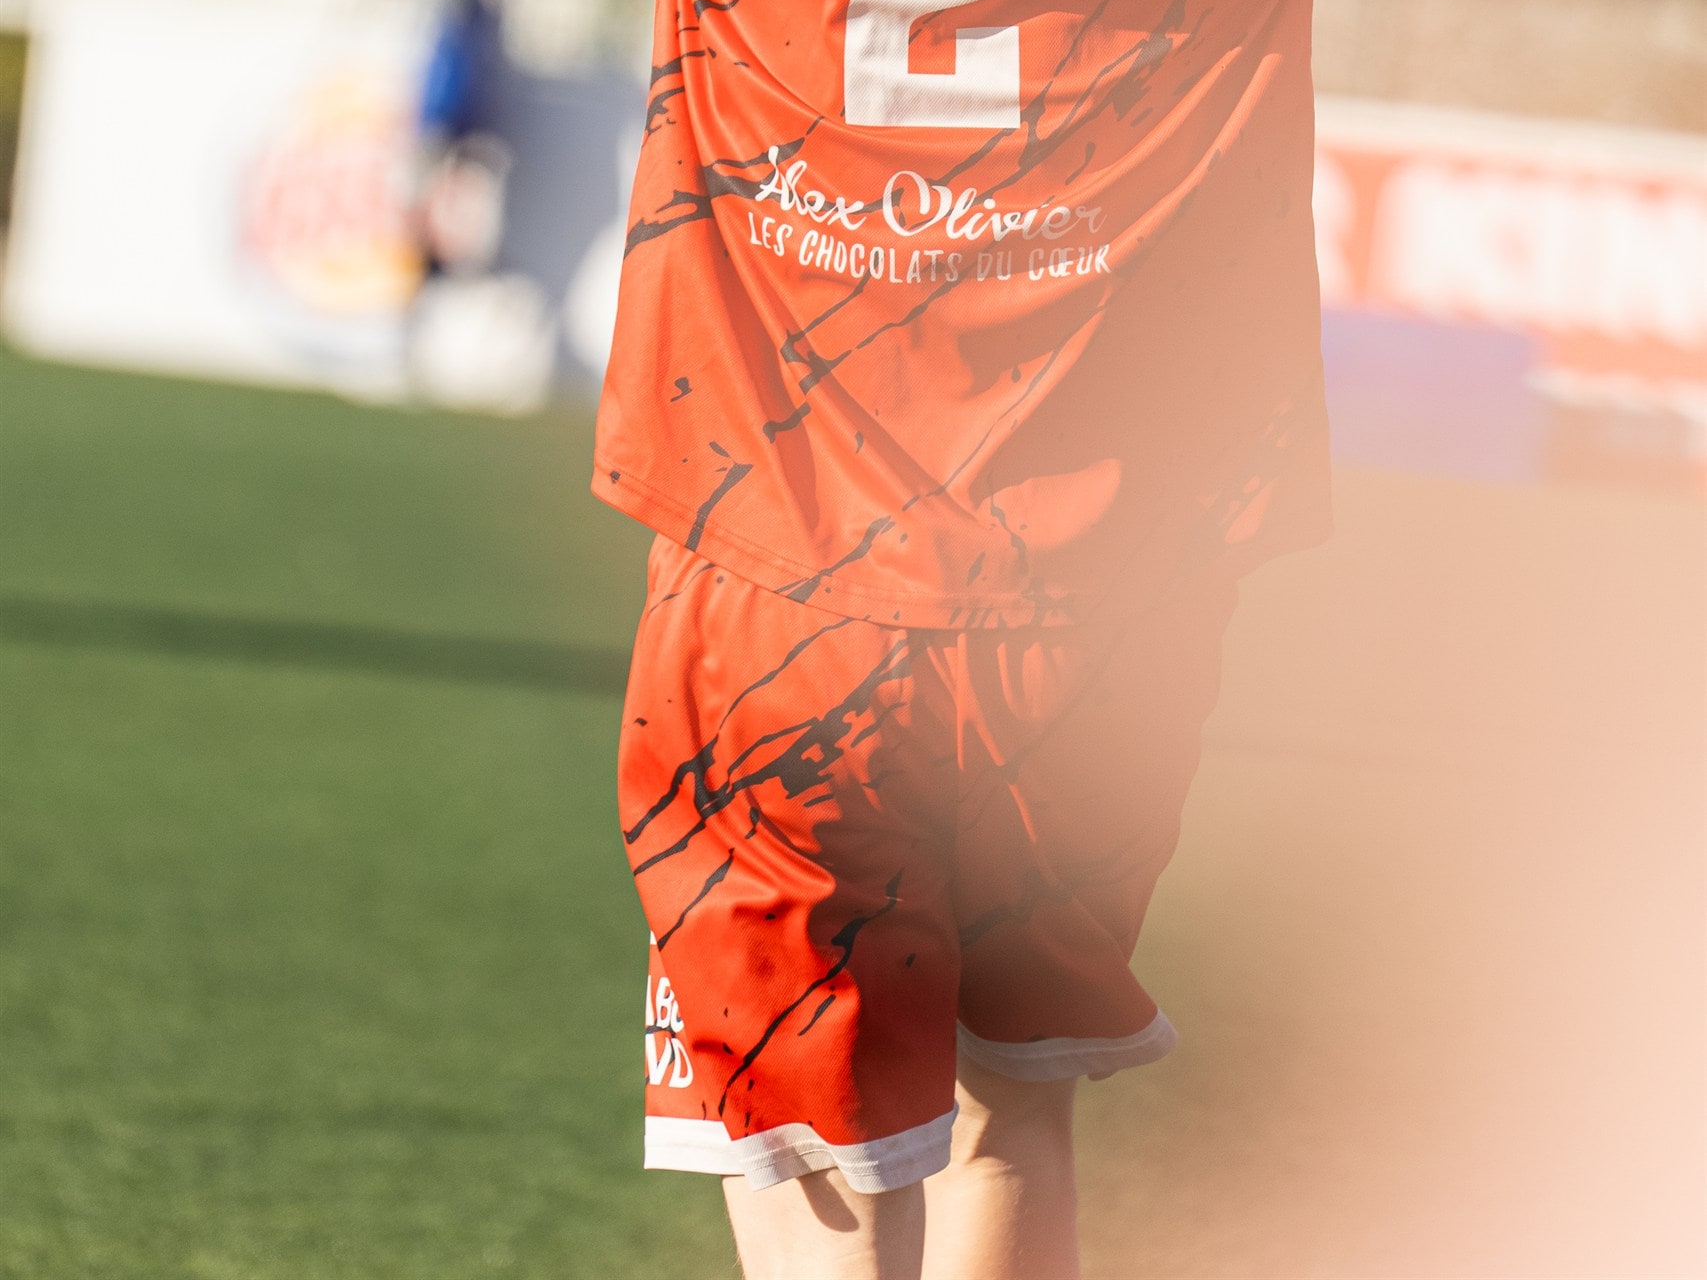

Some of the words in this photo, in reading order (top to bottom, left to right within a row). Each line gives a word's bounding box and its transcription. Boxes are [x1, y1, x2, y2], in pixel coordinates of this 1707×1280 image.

[755, 145, 867, 231] Alex
[882, 170, 1107, 242] Olivier
[748, 211, 793, 257] LES
[799, 230, 963, 284] CHOCOLATS
[976, 251, 1012, 282] DU
[1028, 243, 1112, 281] CŒUR
